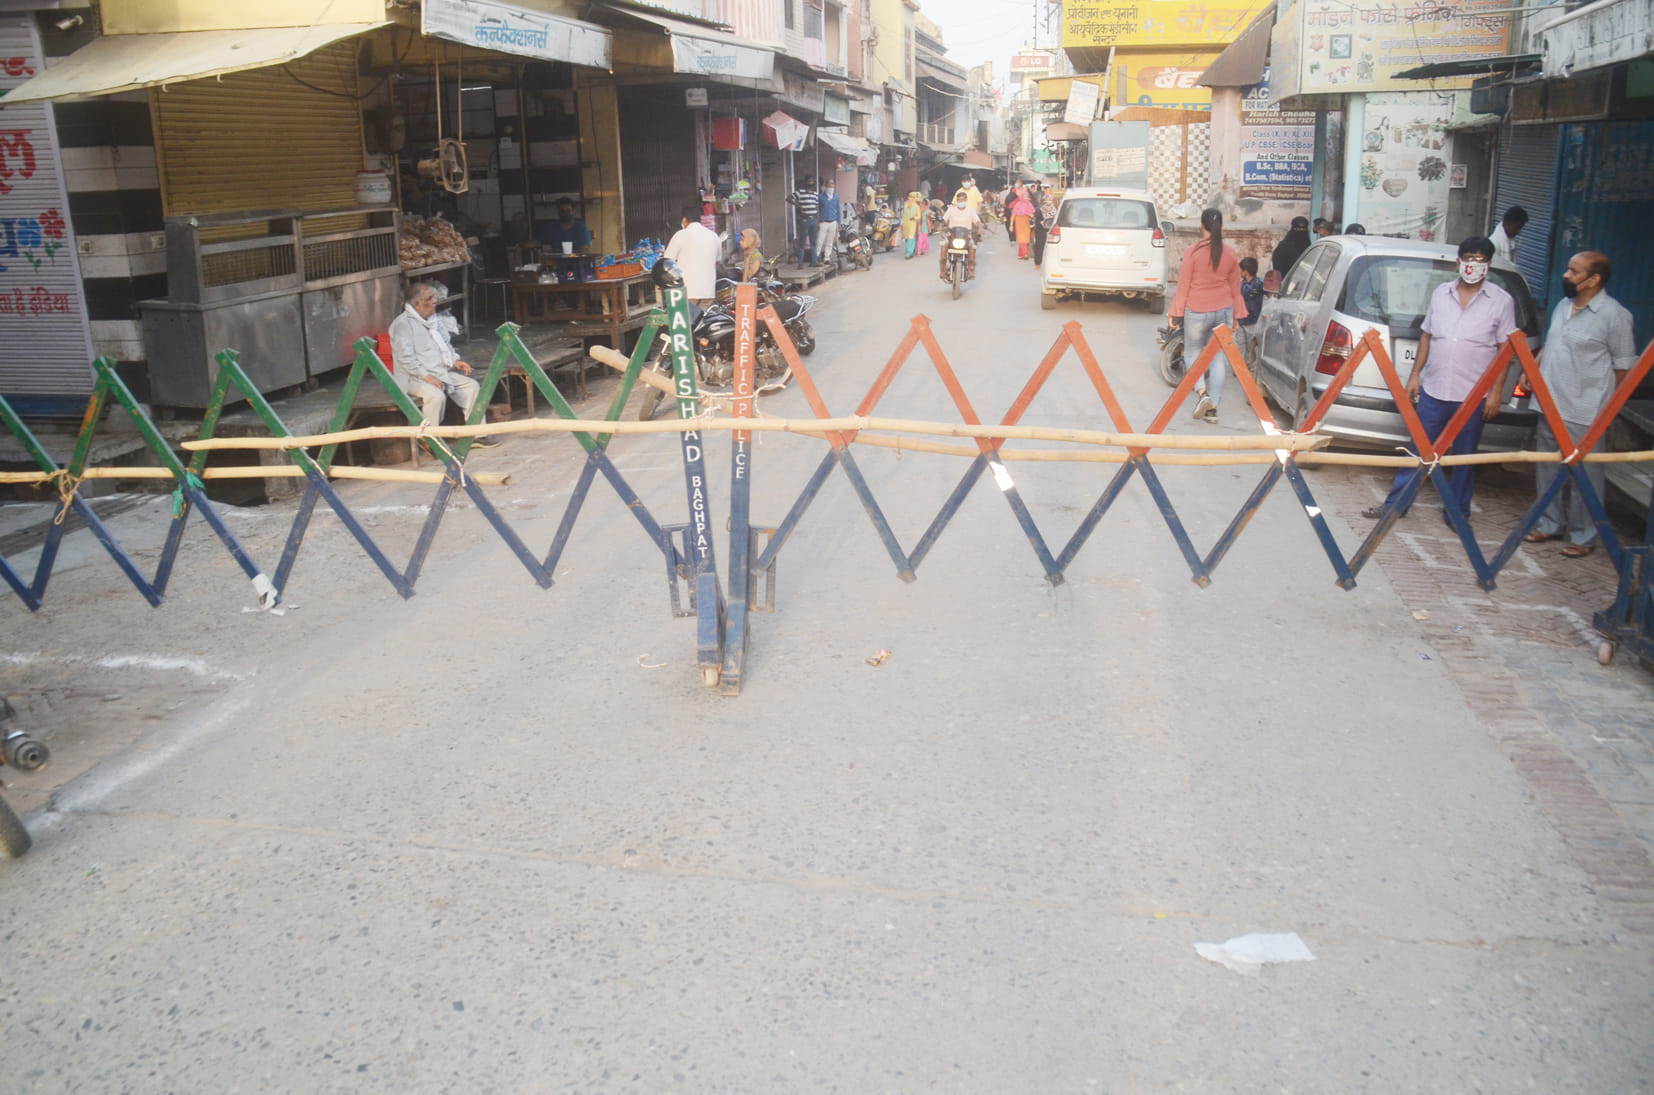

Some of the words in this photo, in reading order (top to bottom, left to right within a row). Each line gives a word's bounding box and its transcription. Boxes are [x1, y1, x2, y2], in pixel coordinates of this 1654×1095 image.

[1359, 3, 1399, 25] फोटो
[1252, 130, 1270, 138] Class
[1269, 152, 1286, 160] Other
[737, 304, 752, 395] TRAFFIC
[669, 289, 701, 463] PARISHAD
[691, 475, 708, 559] BAGHPAT
[735, 403, 747, 480] PLICE
